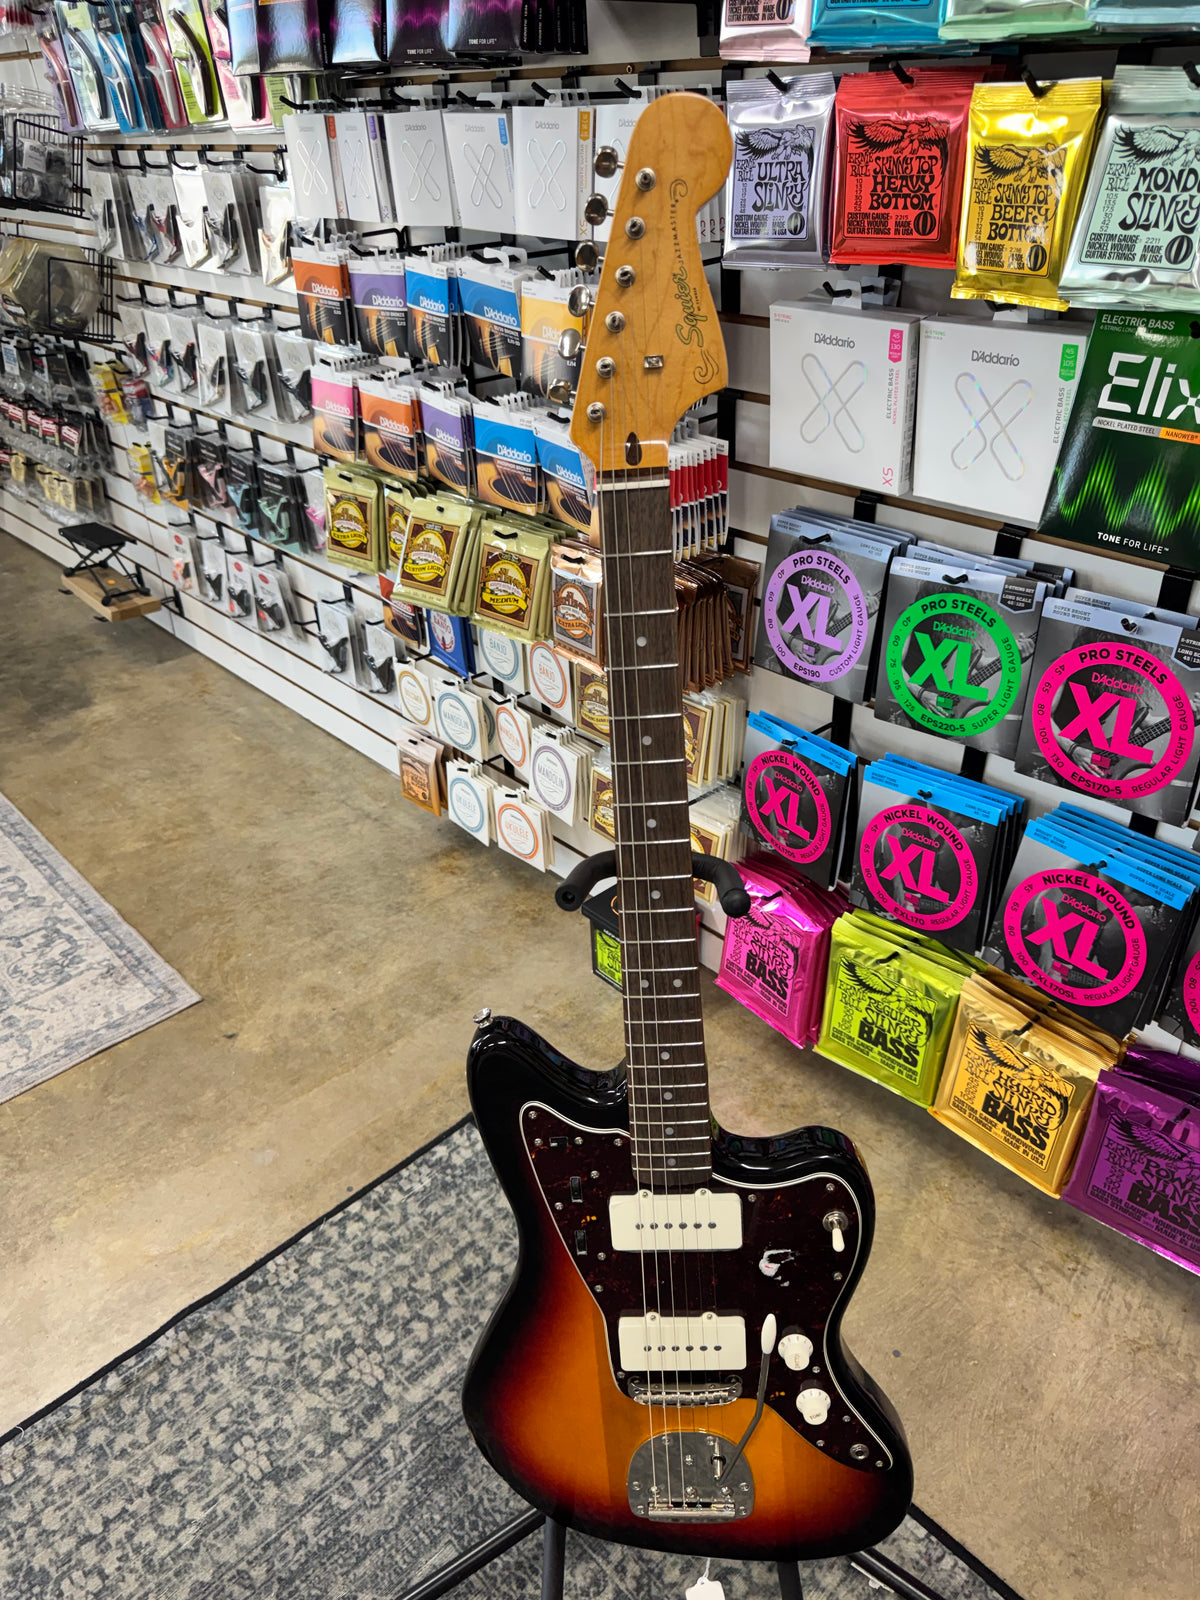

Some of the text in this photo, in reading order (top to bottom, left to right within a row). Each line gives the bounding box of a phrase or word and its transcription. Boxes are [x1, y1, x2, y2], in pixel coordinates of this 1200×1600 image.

[757, 160, 806, 182] ULTRA
[873, 155, 938, 175] SKINNY TOP
[872, 174, 934, 194] HEAVY
[1132, 166, 1200, 194] MOND
[752, 181, 806, 212] SLINKY
[868, 193, 932, 211] BOTTOM
[995, 183, 1052, 205] SKINNY TOP
[847, 213, 890, 221] CUSTOM GAUGE
[847, 220, 866, 229] NICKEL
[990, 204, 1050, 224] BEEFY
[847, 227, 913, 236] GUITAR STRINGS IN USA
[1089, 233, 1117, 242] CUSTOM
[1118, 234, 1140, 243] GAUGE
[1084, 250, 1163, 264] GUITAR STRINGS IN USA
[1087, 241, 1164, 254] NICKEL WOUND MADE
[371, 295, 404, 308] D'Addario
[419, 296, 446, 313] D'Addario
[672, 266, 708, 347] Squier
[483, 305, 518, 327] D'Addario
[1102, 314, 1175, 331] ELECTRIC BASS
[813, 332, 856, 349] D'Addario
[971, 350, 1020, 367] D'Addario
[886, 388, 894, 419] ELECTRIC
[1053, 387, 1065, 444] ELECTRIC BASS
[1097, 420, 1155, 434] NICKEL PLATED STEEL
[496, 443, 532, 464] D'Addario
[555, 464, 583, 485] D'Addario
[882, 467, 894, 487] XS
[333, 532, 350, 540] EXTRA
[1097, 531, 1121, 544] TONE
[1123, 538, 1141, 549] FOR
[405, 564, 444, 573] CUSTOM LIGHT
[793, 555, 851, 585] PRO STEELS
[489, 596, 519, 605] MEDIUM
[921, 599, 997, 628] PRO STEELS
[557, 619, 575, 629] EXTRA
[781, 582, 843, 652] XL
[933, 621, 977, 639] D'Addario
[828, 593, 864, 677] CUSTOM LIGHT GAUGE
[793, 662, 821, 678] EPS190
[908, 631, 989, 702] XL
[1078, 648, 1110, 664] PRO
[1115, 649, 1168, 685] STEELS
[972, 636, 1016, 731] SUPER LIGHT GAUGE
[1091, 672, 1144, 696] D'Addario
[920, 713, 966, 732] EPS220-5
[1037, 664, 1066, 769] 45 65 80 130
[1057, 681, 1154, 765] XL
[1131, 694, 1189, 793] REGULAR LIGHT GAUGE
[761, 754, 821, 796] NICKEL WOUND
[1070, 771, 1123, 795] EPS170-5
[759, 774, 811, 842] XL
[883, 809, 964, 851] NICKEL WOUND
[901, 827, 940, 849] D'Addario
[879, 833, 950, 904] XL
[930, 858, 973, 926] REGULAR LIGHT GAUGE
[1042, 874, 1136, 929] NICKEL WOUND
[893, 907, 925, 926] EXL170
[1061, 893, 1107, 922] D'Addario
[752, 931, 789, 959] SUPER
[1024, 896, 1109, 981] XL
[745, 949, 789, 1000] BASS
[1083, 938, 1140, 1001] REGULAR LIGHT GAUGE
[1030, 969, 1077, 1000] EXL170SL
[865, 1007, 920, 1048] SLINKY
[866, 996, 923, 1035] REGULAR
[858, 1017, 920, 1068] BASS
[993, 1080, 1052, 1132] SLINKY
[997, 1070, 1057, 1116] HYBRID
[981, 1091, 1050, 1151] BASS
[1003, 1136, 1020, 1150] MADE
[1031, 1153, 1044, 1166] USA
